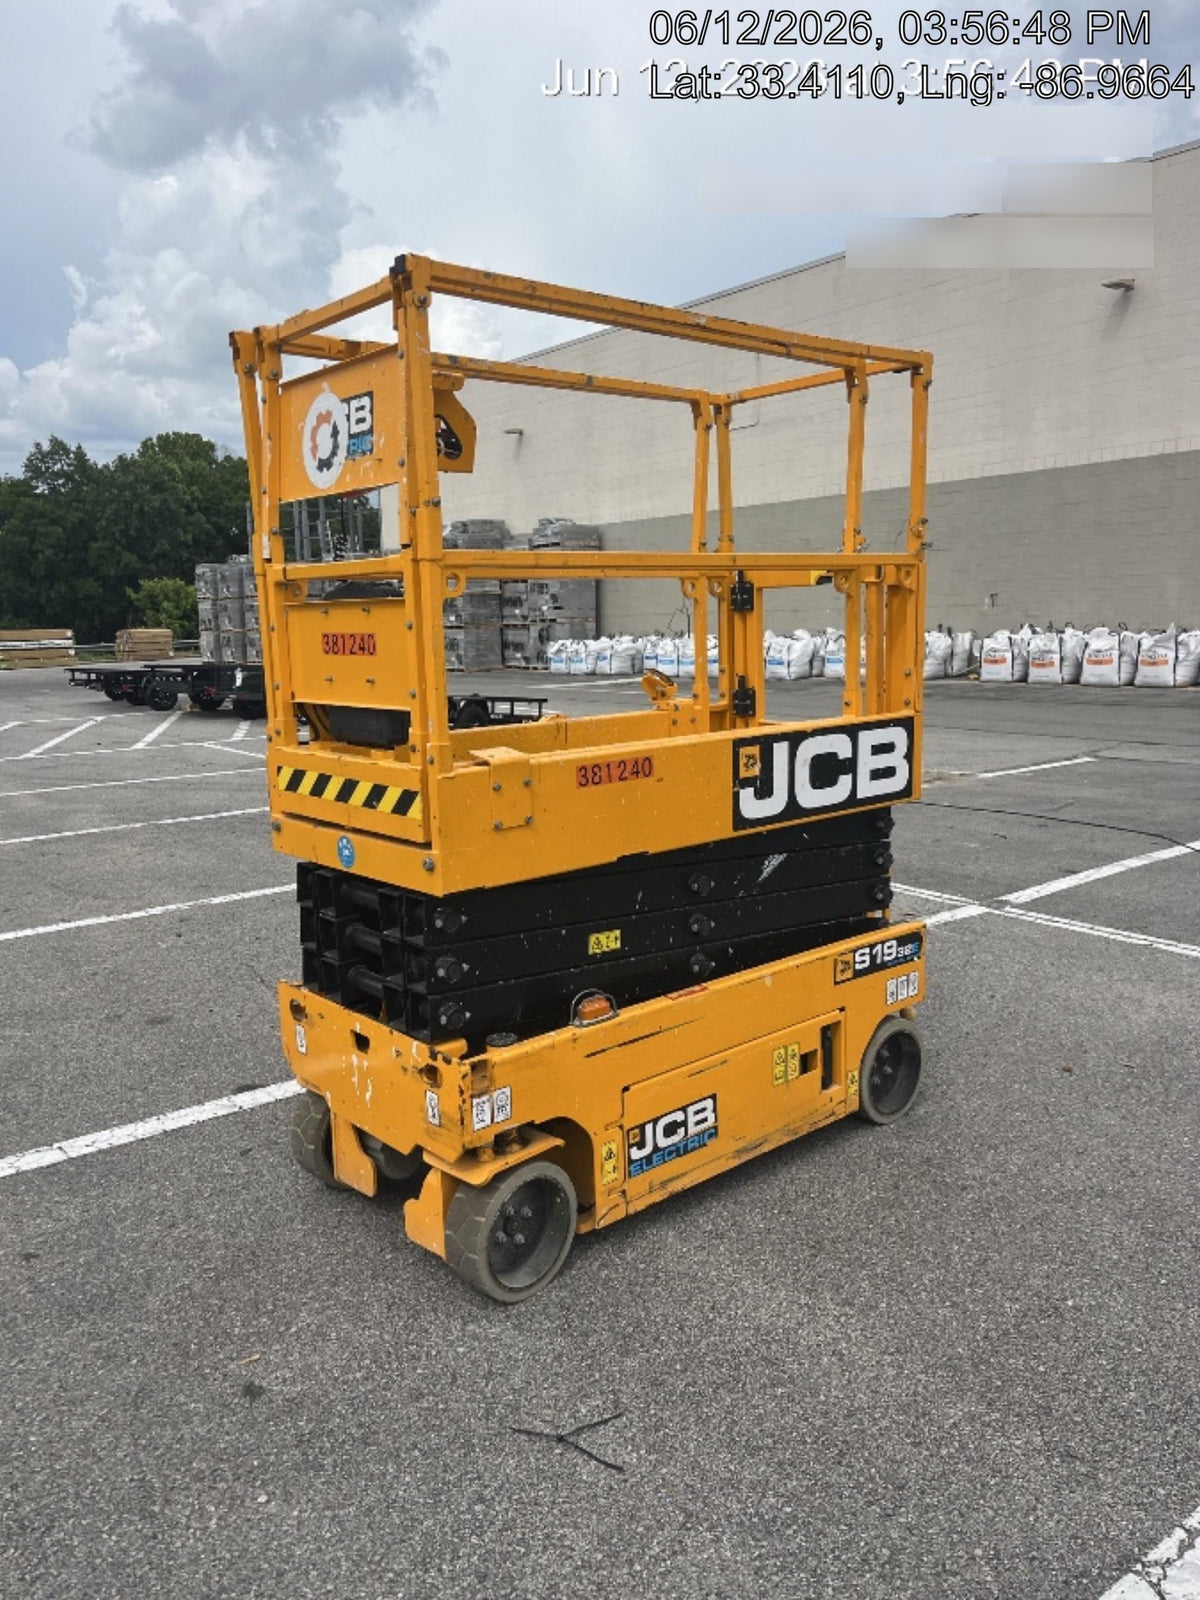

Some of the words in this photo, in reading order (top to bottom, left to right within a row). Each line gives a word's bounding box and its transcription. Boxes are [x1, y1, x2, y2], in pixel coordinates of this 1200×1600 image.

[323, 633, 376, 656] 381240
[578, 757, 653, 787] 381240
[738, 725, 910, 820] JCB
[629, 1098, 716, 1160] JCB
[629, 1128, 716, 1178] ELECTRIC
